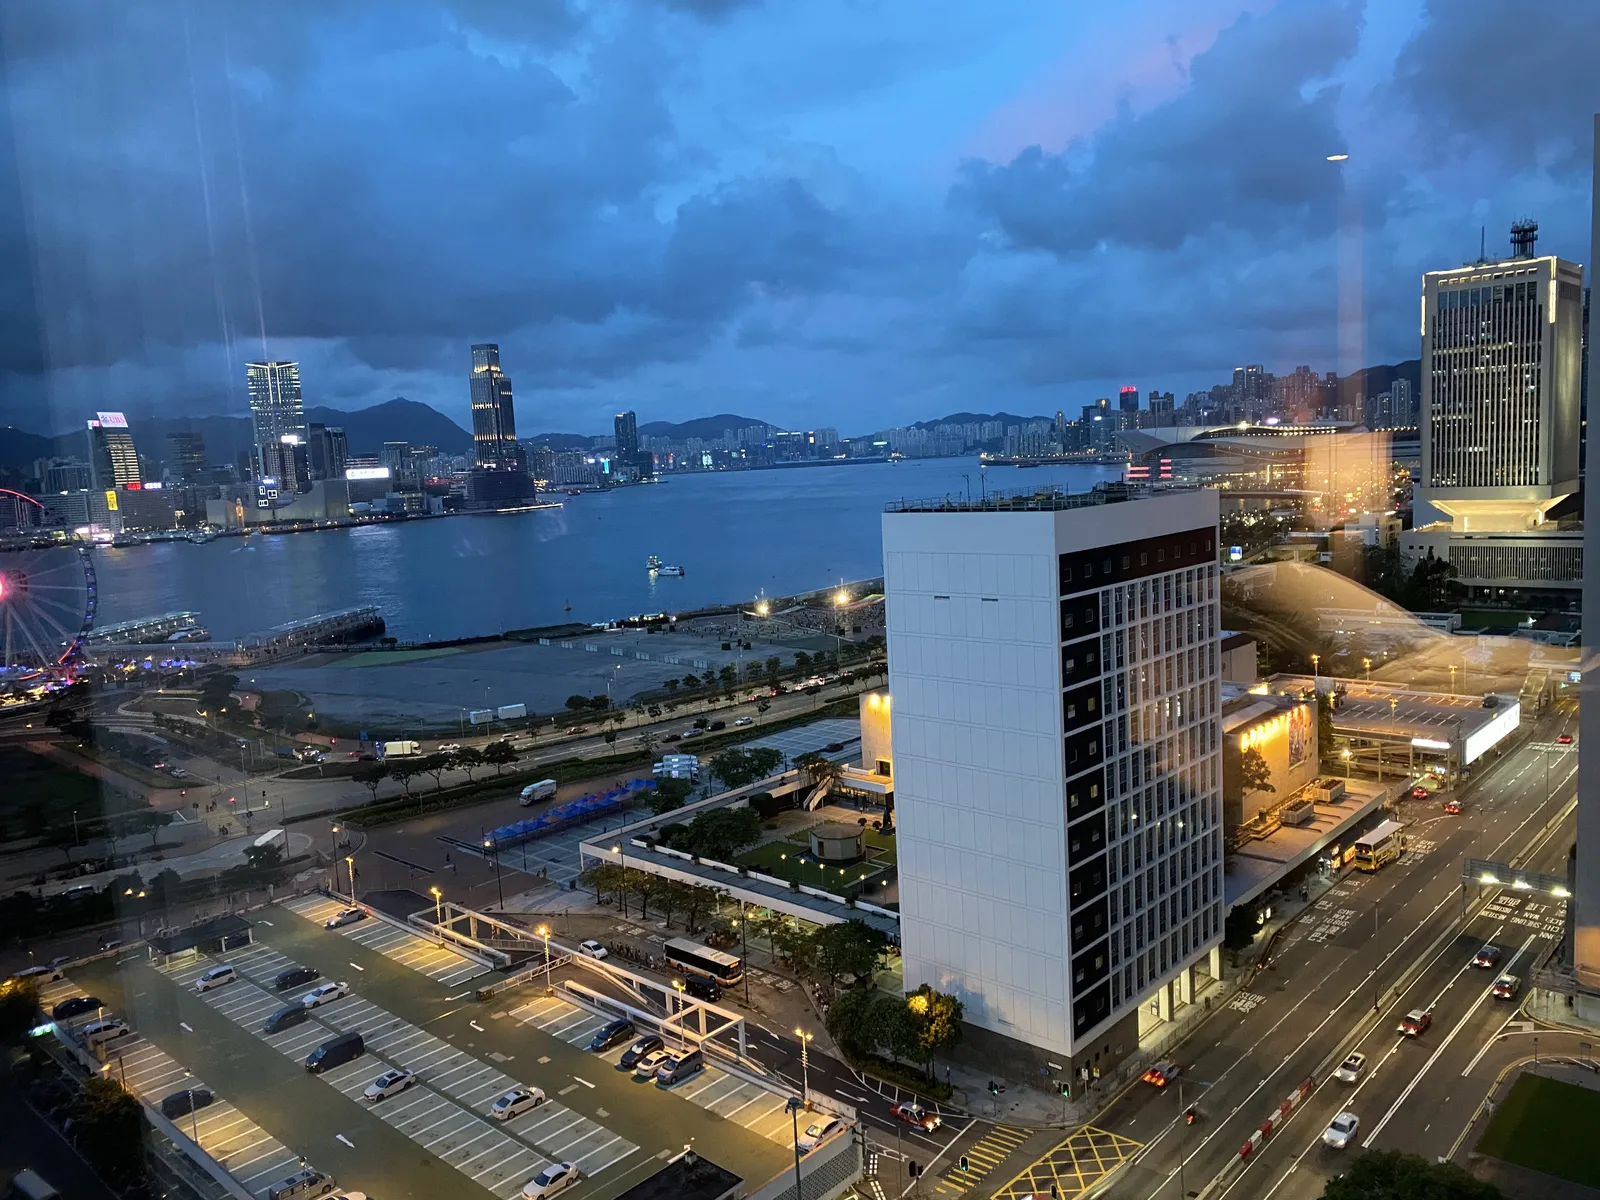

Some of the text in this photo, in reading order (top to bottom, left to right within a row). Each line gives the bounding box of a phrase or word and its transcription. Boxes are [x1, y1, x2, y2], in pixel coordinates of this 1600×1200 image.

[1329, 889, 1350, 897] STOP
[1314, 900, 1333, 910] 巴士
[1337, 908, 1357, 916] GIVE
[1522, 912, 1541, 921] WAN
[1332, 913, 1351, 921] WAY
[1332, 919, 1350, 927] BUS
[1510, 916, 1542, 929] SHEUNG
[1307, 931, 1328, 943] 巴士
[1239, 992, 1266, 1003] SLOW
